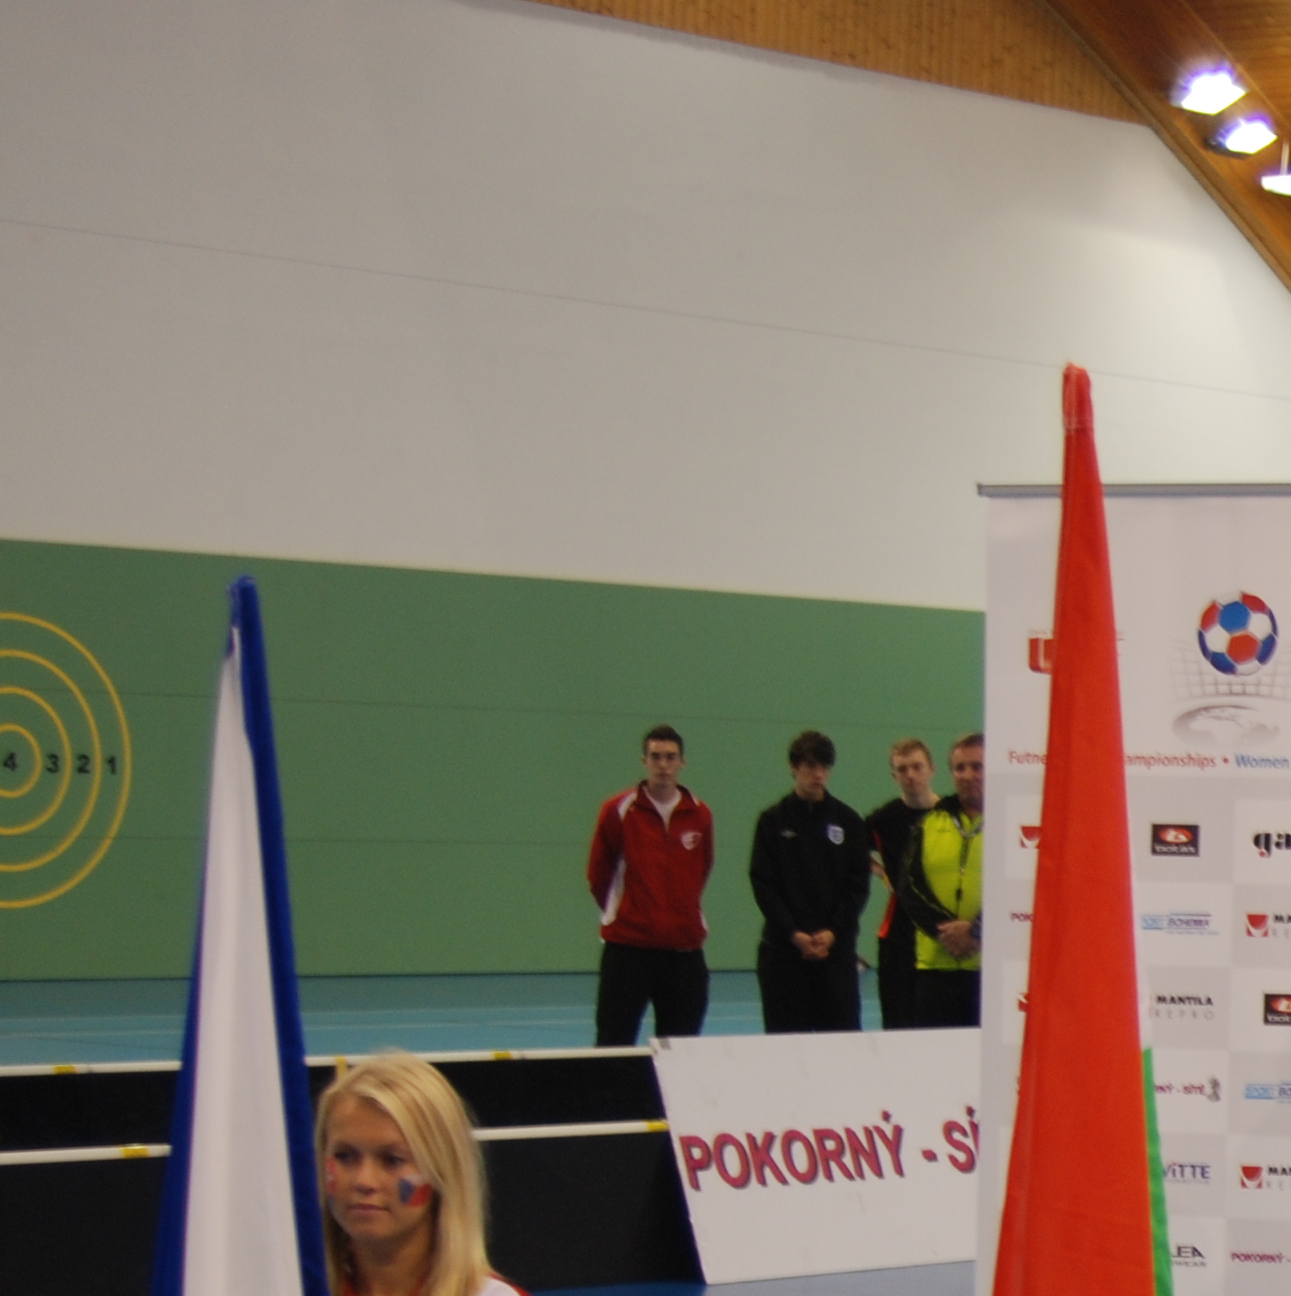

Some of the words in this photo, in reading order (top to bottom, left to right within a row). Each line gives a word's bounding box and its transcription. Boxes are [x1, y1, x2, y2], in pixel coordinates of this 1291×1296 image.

[4, 752, 17, 772] 4
[45, 754, 60, 774] 3
[76, 754, 91, 774] 2
[107, 756, 117, 774] 1
[1008, 751, 1048, 766] Futne
[1126, 753, 1217, 771] ampionships
[1235, 754, 1290, 770] Women
[1156, 995, 1213, 1007] MANTILA
[681, 1111, 904, 1191] POKORNÝ
[943, 1105, 979, 1173] SÍ
